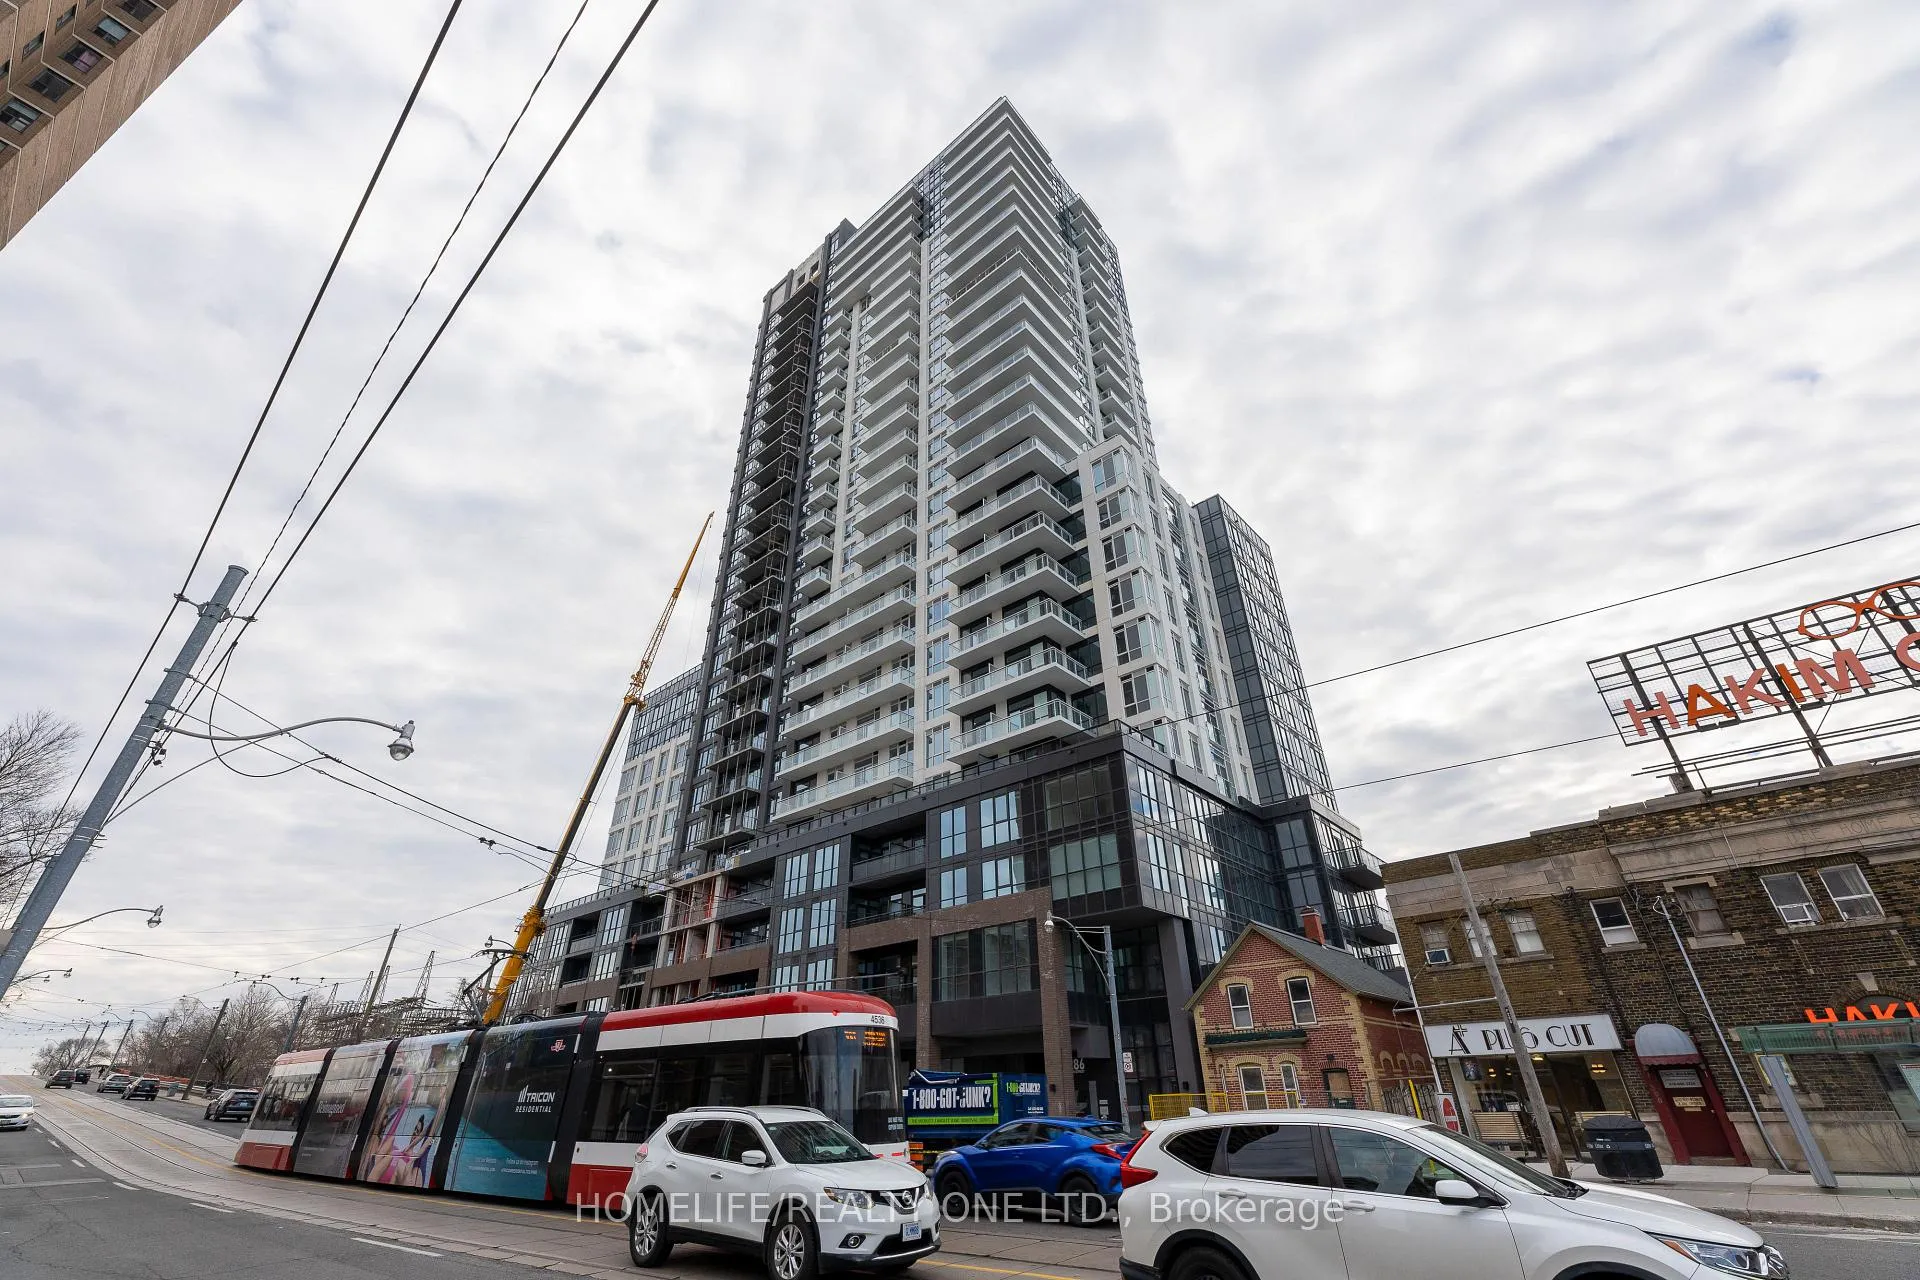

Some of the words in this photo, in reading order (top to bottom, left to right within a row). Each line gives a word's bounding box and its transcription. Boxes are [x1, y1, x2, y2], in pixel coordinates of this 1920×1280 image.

[1623, 648, 1876, 737] HAKIM
[871, 1015, 885, 1025] 4536
[1546, 1023, 1595, 1047] CUT
[526, 1092, 555, 1103] TRICON
[515, 1105, 552, 1113] RESIDENTIAL
